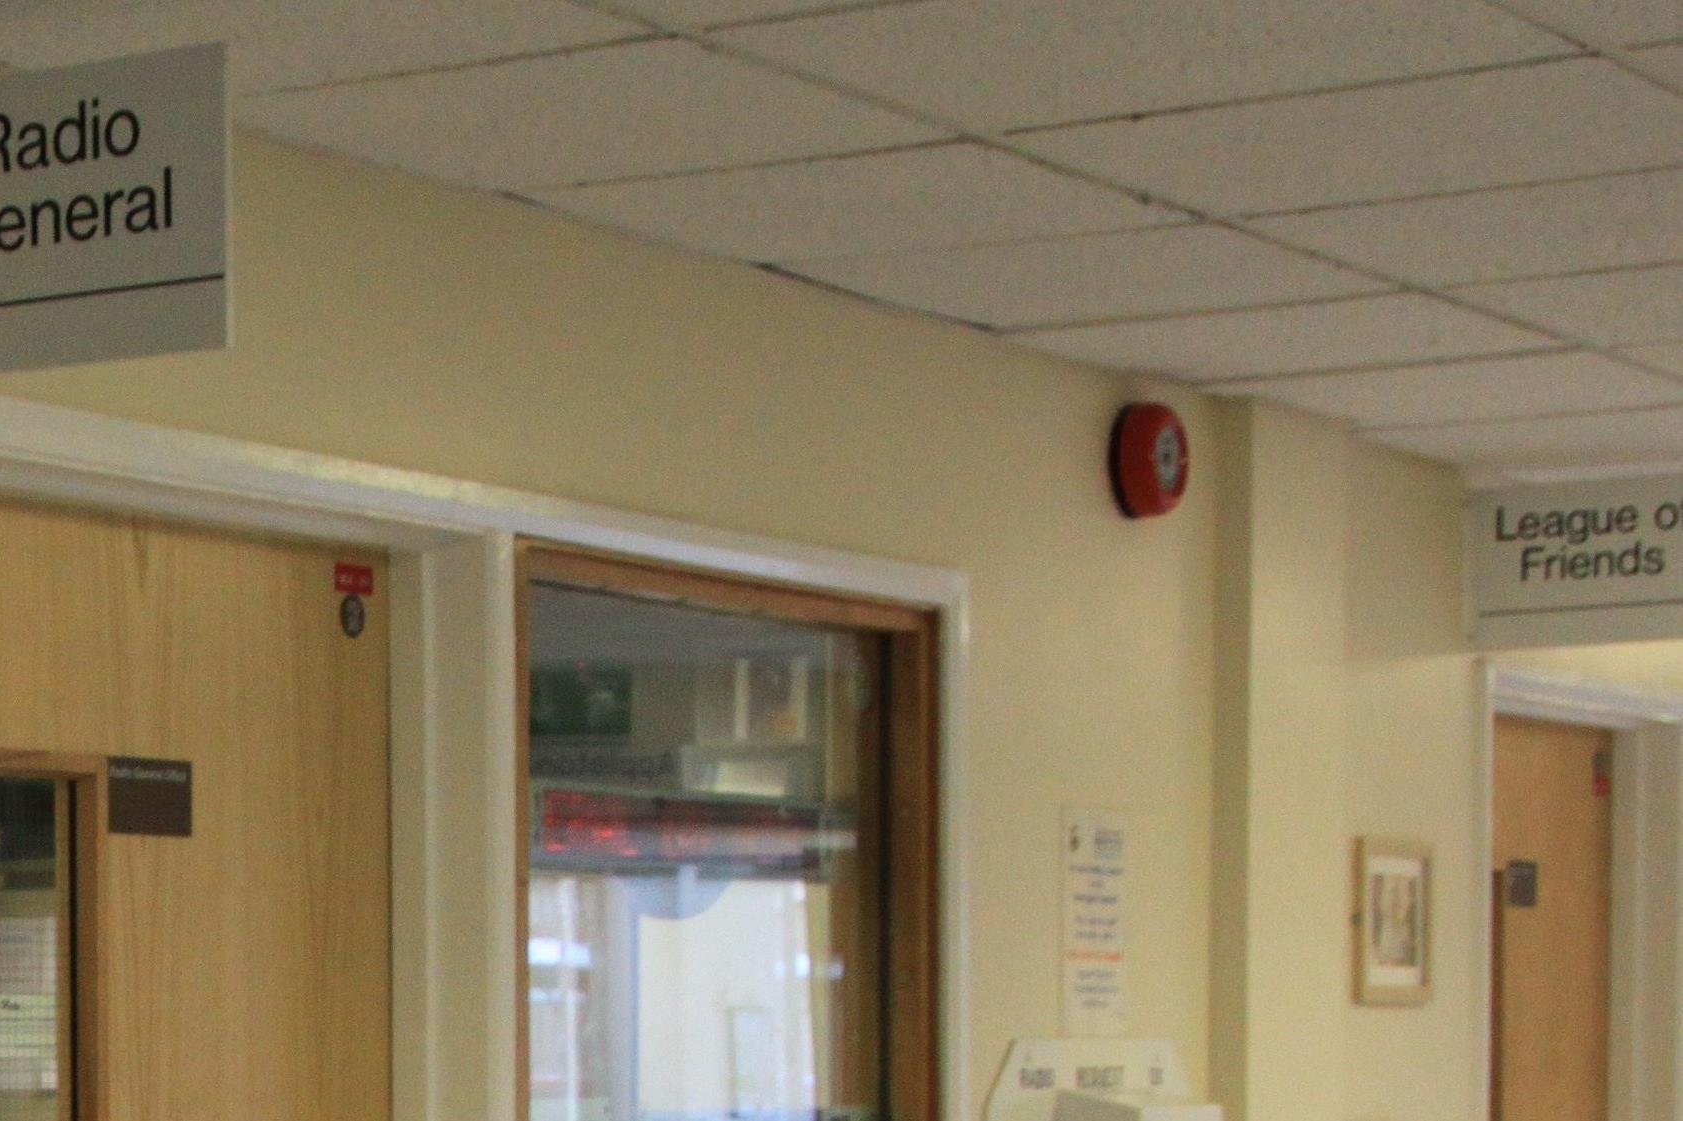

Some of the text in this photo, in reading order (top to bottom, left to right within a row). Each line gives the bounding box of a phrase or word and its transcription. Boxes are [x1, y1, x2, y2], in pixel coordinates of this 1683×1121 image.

[1494, 498, 1683, 546] League o
[1519, 539, 1668, 583] Friends
